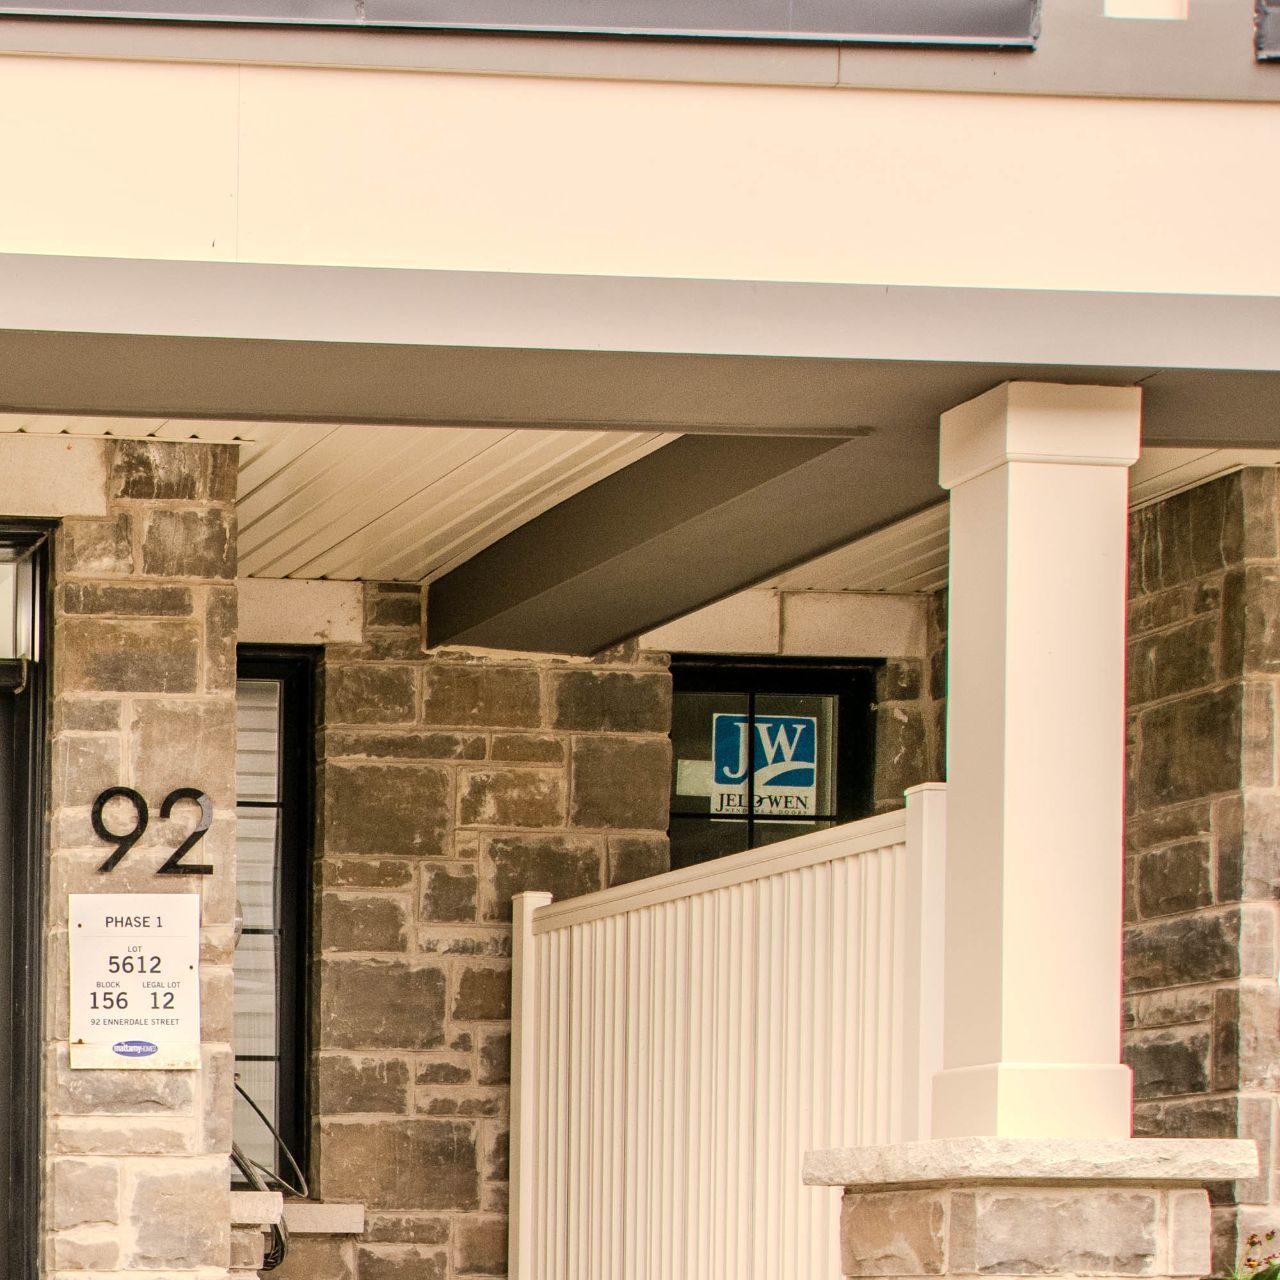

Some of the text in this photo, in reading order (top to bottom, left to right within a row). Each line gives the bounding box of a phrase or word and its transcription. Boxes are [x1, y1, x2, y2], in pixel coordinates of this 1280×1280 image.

[723, 722, 807, 779] JW
[91, 786, 214, 875] 92
[105, 916, 163, 928] PHASE 1
[127, 945, 142, 953] LOT
[108, 955, 162, 974] 5612
[96, 981, 121, 989] BLOCK
[142, 981, 181, 989] LEGAL LOT
[90, 991, 129, 1010] 156
[150, 991, 175, 1010] 12
[90, 1018, 180, 1026] 92 ENNERDALE STREET
